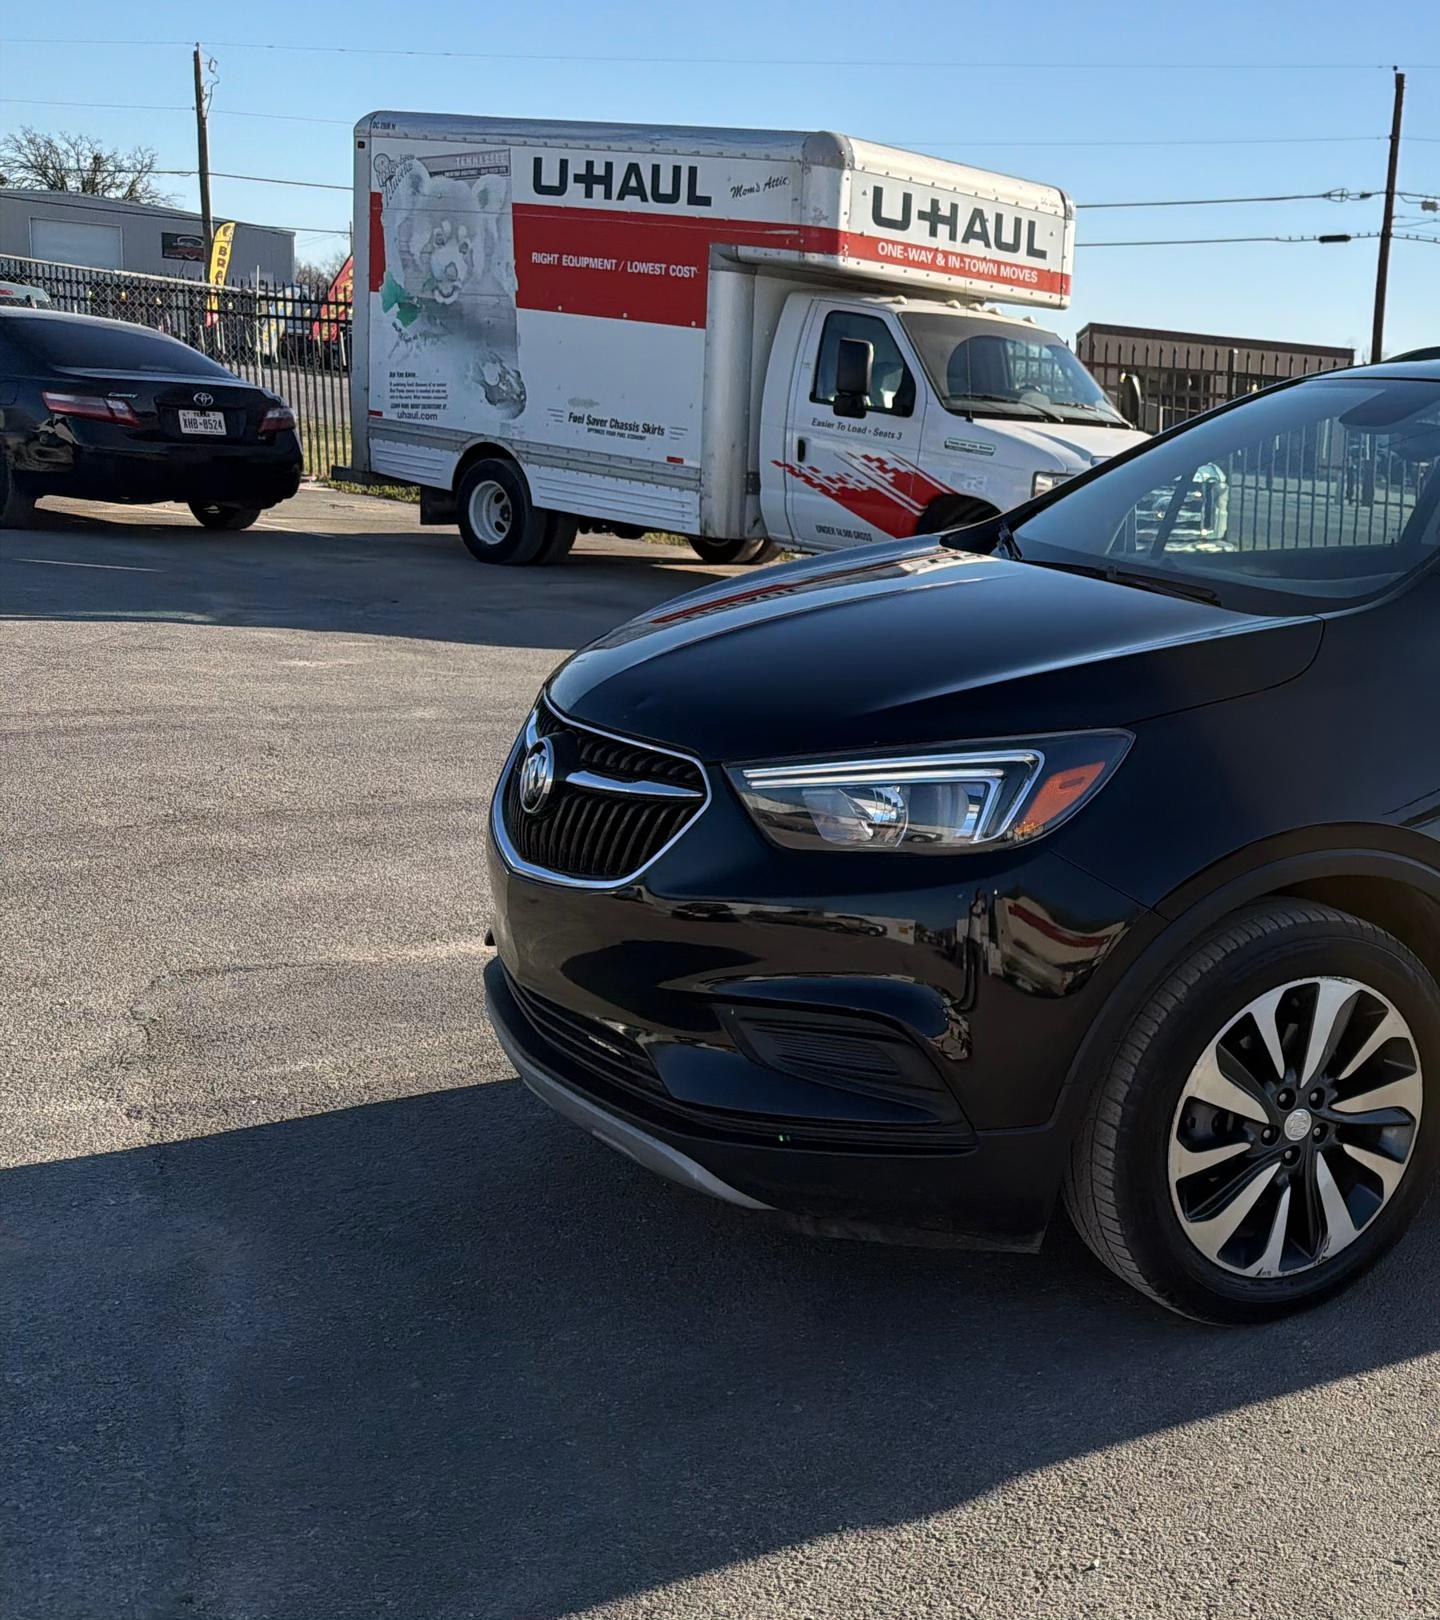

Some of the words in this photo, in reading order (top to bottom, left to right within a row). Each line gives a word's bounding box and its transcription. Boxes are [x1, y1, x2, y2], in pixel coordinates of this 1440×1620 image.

[531, 252, 560, 266] RIGHT
[562, 254, 617, 271] EQUIPMENT
[627, 260, 667, 276] LOWEST
[877, 241, 934, 265] ONE-WAY
[936, 254, 946, 267] &
[947, 255, 998, 277] IN-TOWN
[999, 265, 1038, 284] MOVES
[397, 409, 438, 421] uhaul.com
[568, 412, 585, 425] Fuel
[609, 418, 640, 433] Chassis
[641, 423, 665, 437] Skirts
[811, 417, 835, 429] Easier
[837, 421, 846, 430] To
[847, 423, 867, 434] Load
[873, 427, 895, 440] Seats
[896, 432, 903, 441] 3
